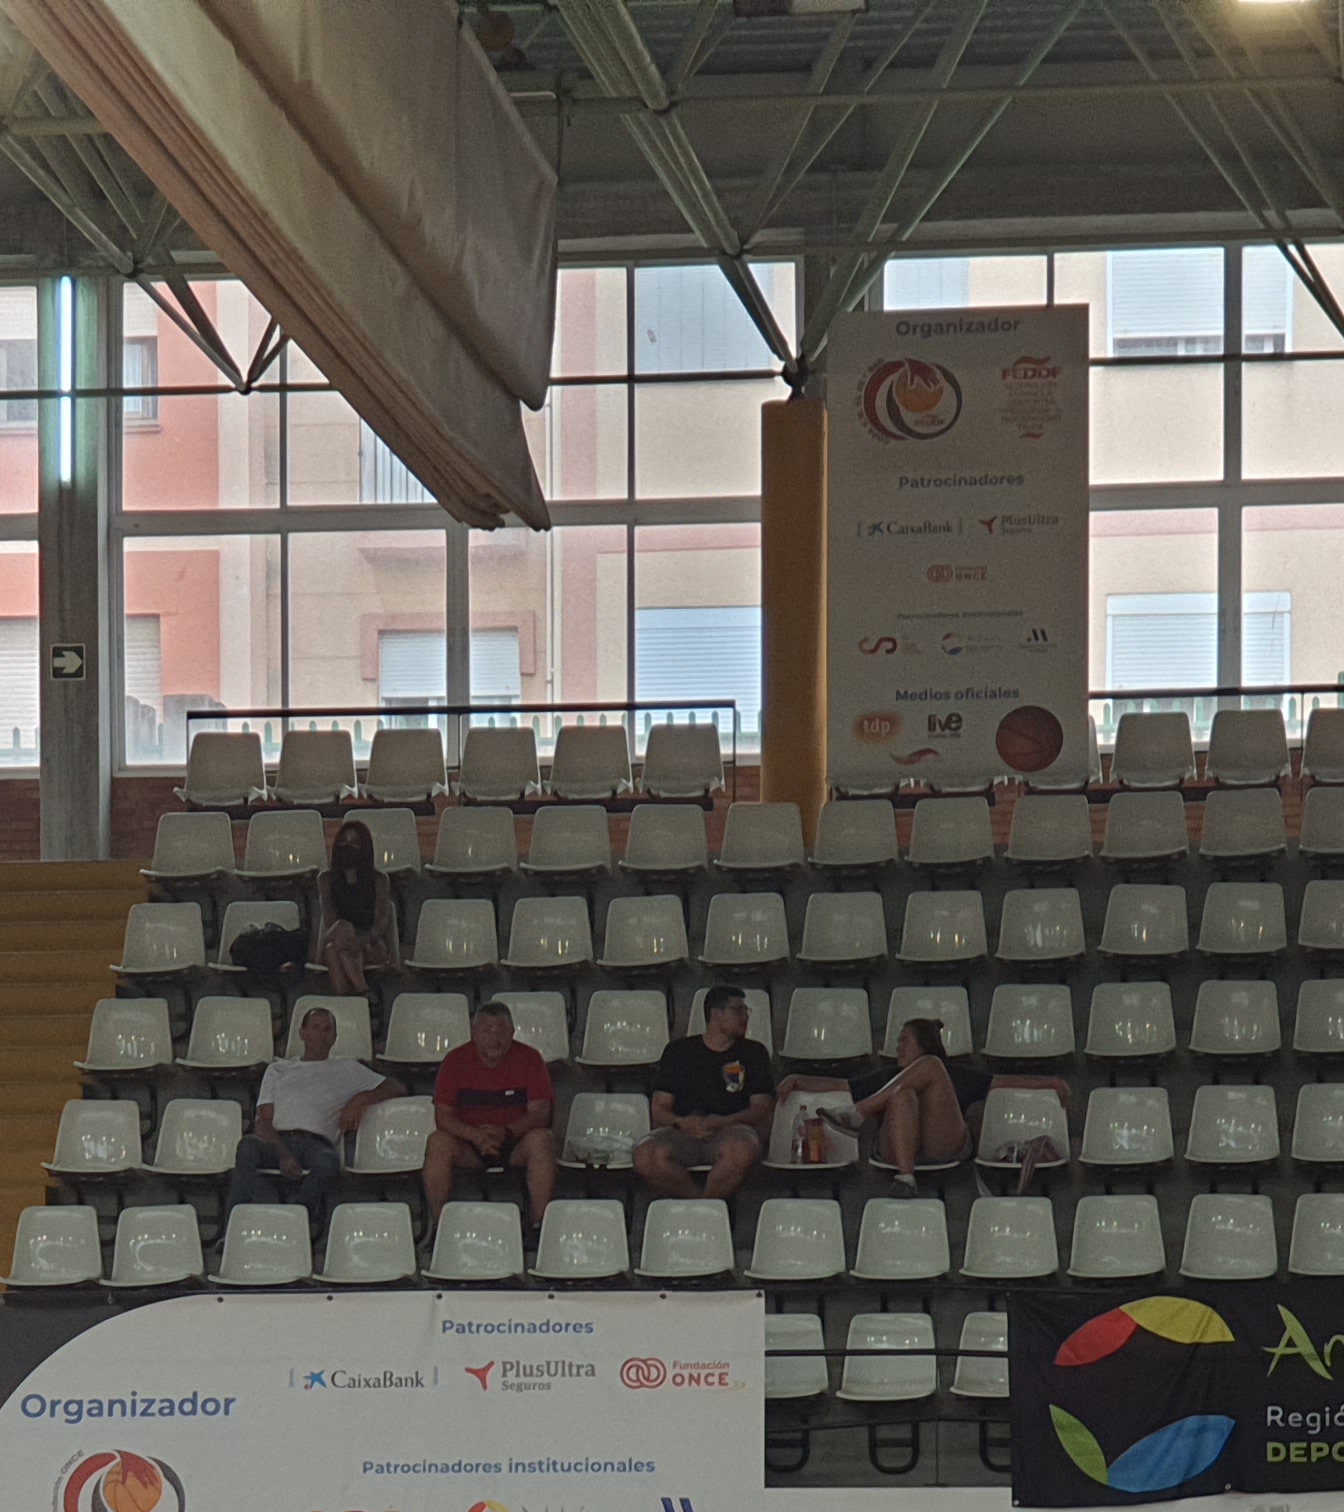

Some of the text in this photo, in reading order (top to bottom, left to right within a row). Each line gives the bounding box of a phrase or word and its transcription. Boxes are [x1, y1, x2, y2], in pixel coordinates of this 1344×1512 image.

[896, 318, 1021, 338] Organizador
[898, 474, 1024, 489] Patrocinadores
[886, 520, 953, 535] CaixaBank
[896, 687, 1020, 701] Medios oficiales
[863, 718, 891, 736] tdp
[441, 1318, 594, 1335] Patrocinadores
[501, 1360, 596, 1380] PlusUltra
[672, 1360, 730, 1371] Fundación
[330, 1370, 426, 1390] CaixaBank
[501, 1380, 552, 1393] Seguros
[672, 1372, 730, 1388] ONCE
[20, 1390, 237, 1424] Organizador
[362, 1457, 656, 1476] Patrocinadores institucionales
